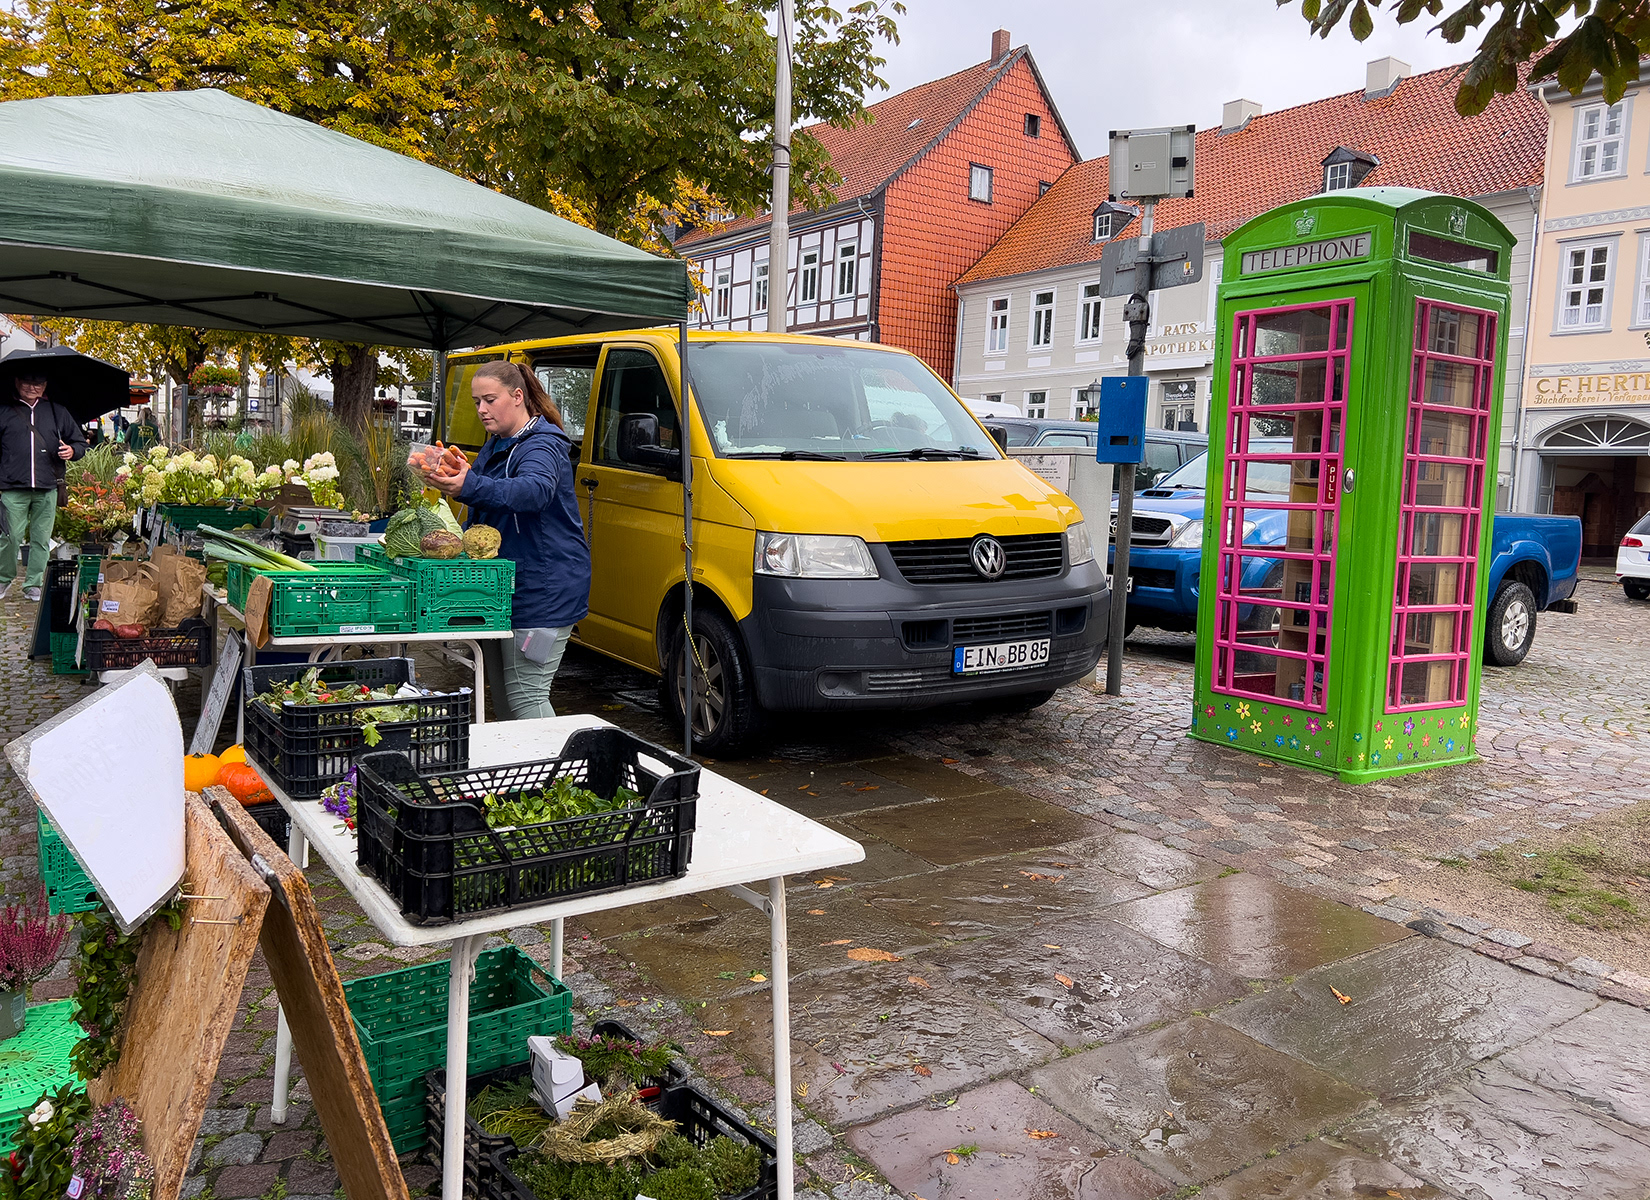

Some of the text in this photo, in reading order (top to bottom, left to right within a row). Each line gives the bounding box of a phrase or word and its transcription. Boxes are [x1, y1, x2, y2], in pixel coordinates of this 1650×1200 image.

[1248, 237, 1366, 271] TELEPHONE
[1163, 323, 1198, 336] RATS
[1534, 393, 1600, 404] Buchdruckerei
[1608, 391, 1650, 403] Verlagsa
[1328, 466, 1336, 499] PULL
[964, 641, 1049, 669] EIN BB 85
